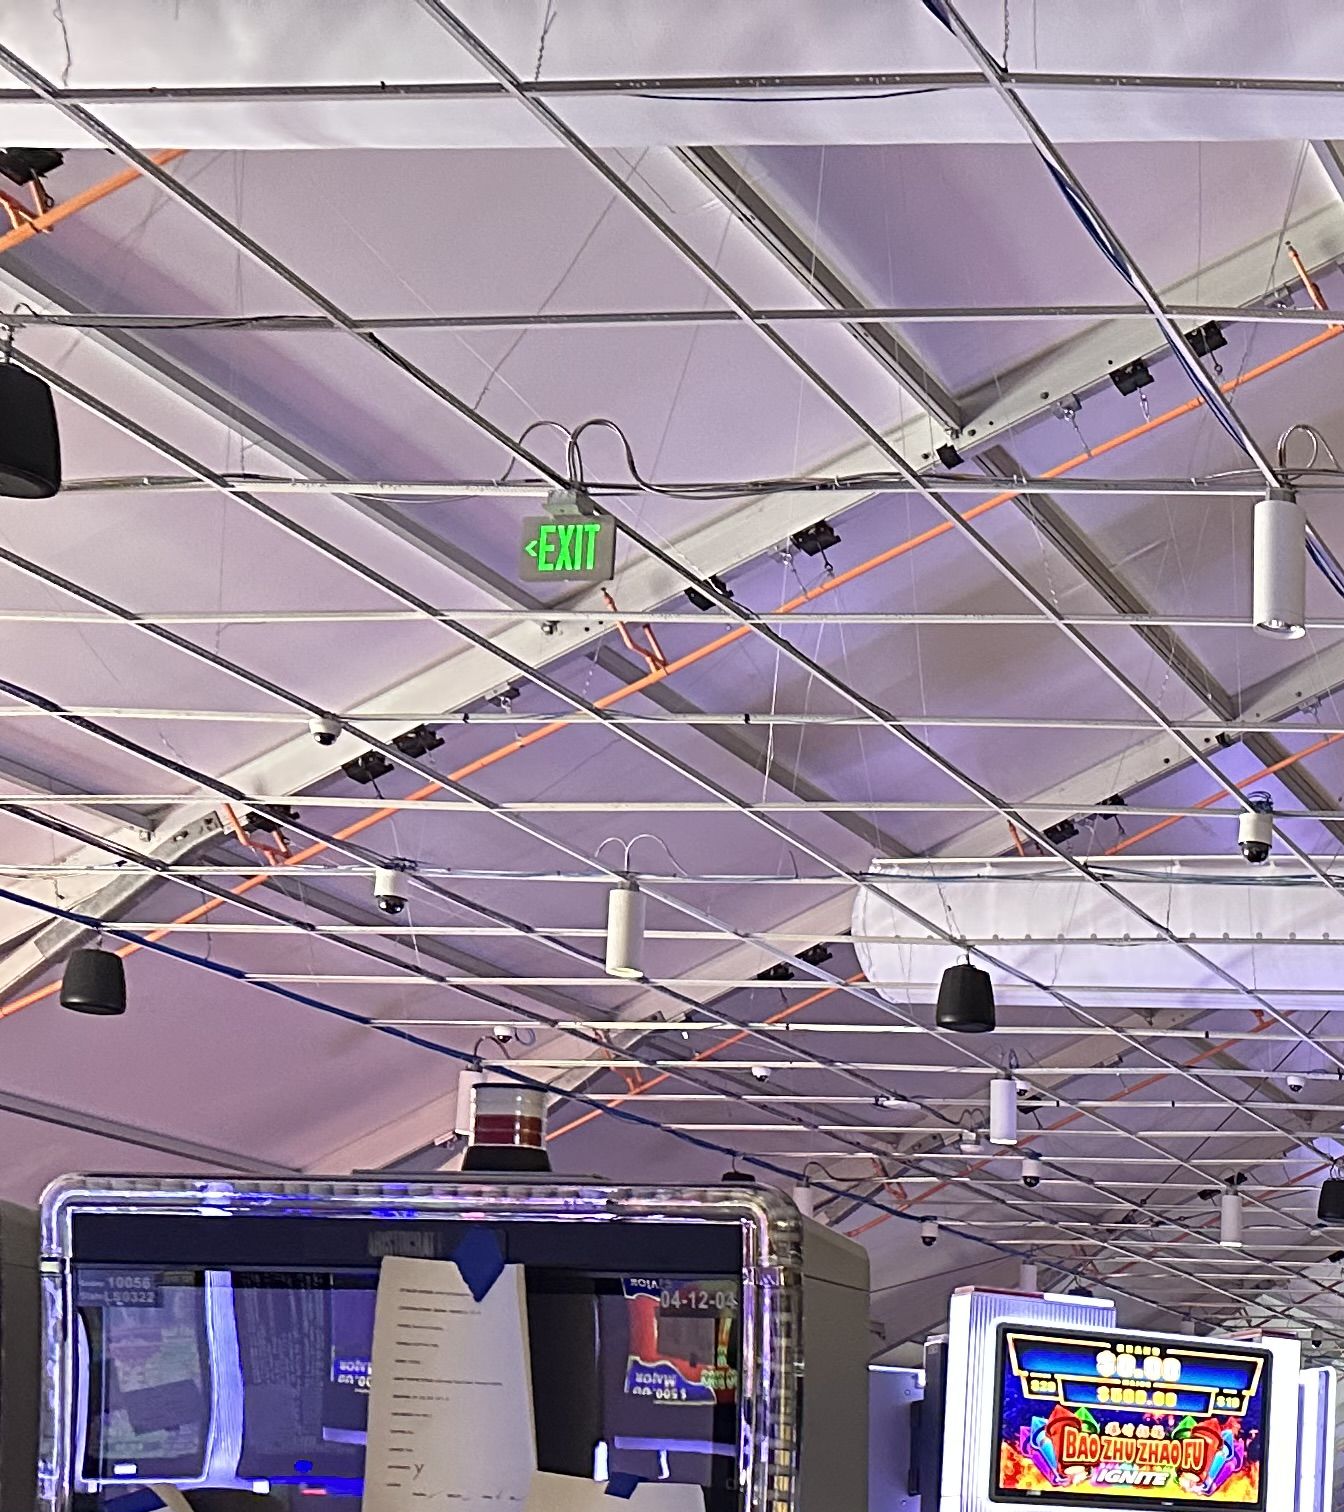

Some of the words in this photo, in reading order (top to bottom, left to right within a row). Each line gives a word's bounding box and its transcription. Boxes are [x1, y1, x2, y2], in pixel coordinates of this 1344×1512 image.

[538, 524, 601, 572] EXIT
[1063, 1427, 1100, 1463] BAO
[1100, 1436, 1137, 1464] ZHU
[1137, 1439, 1182, 1467] ZHAO
[1182, 1438, 1205, 1471] FU
[1096, 1468, 1171, 1486] IGNITE
